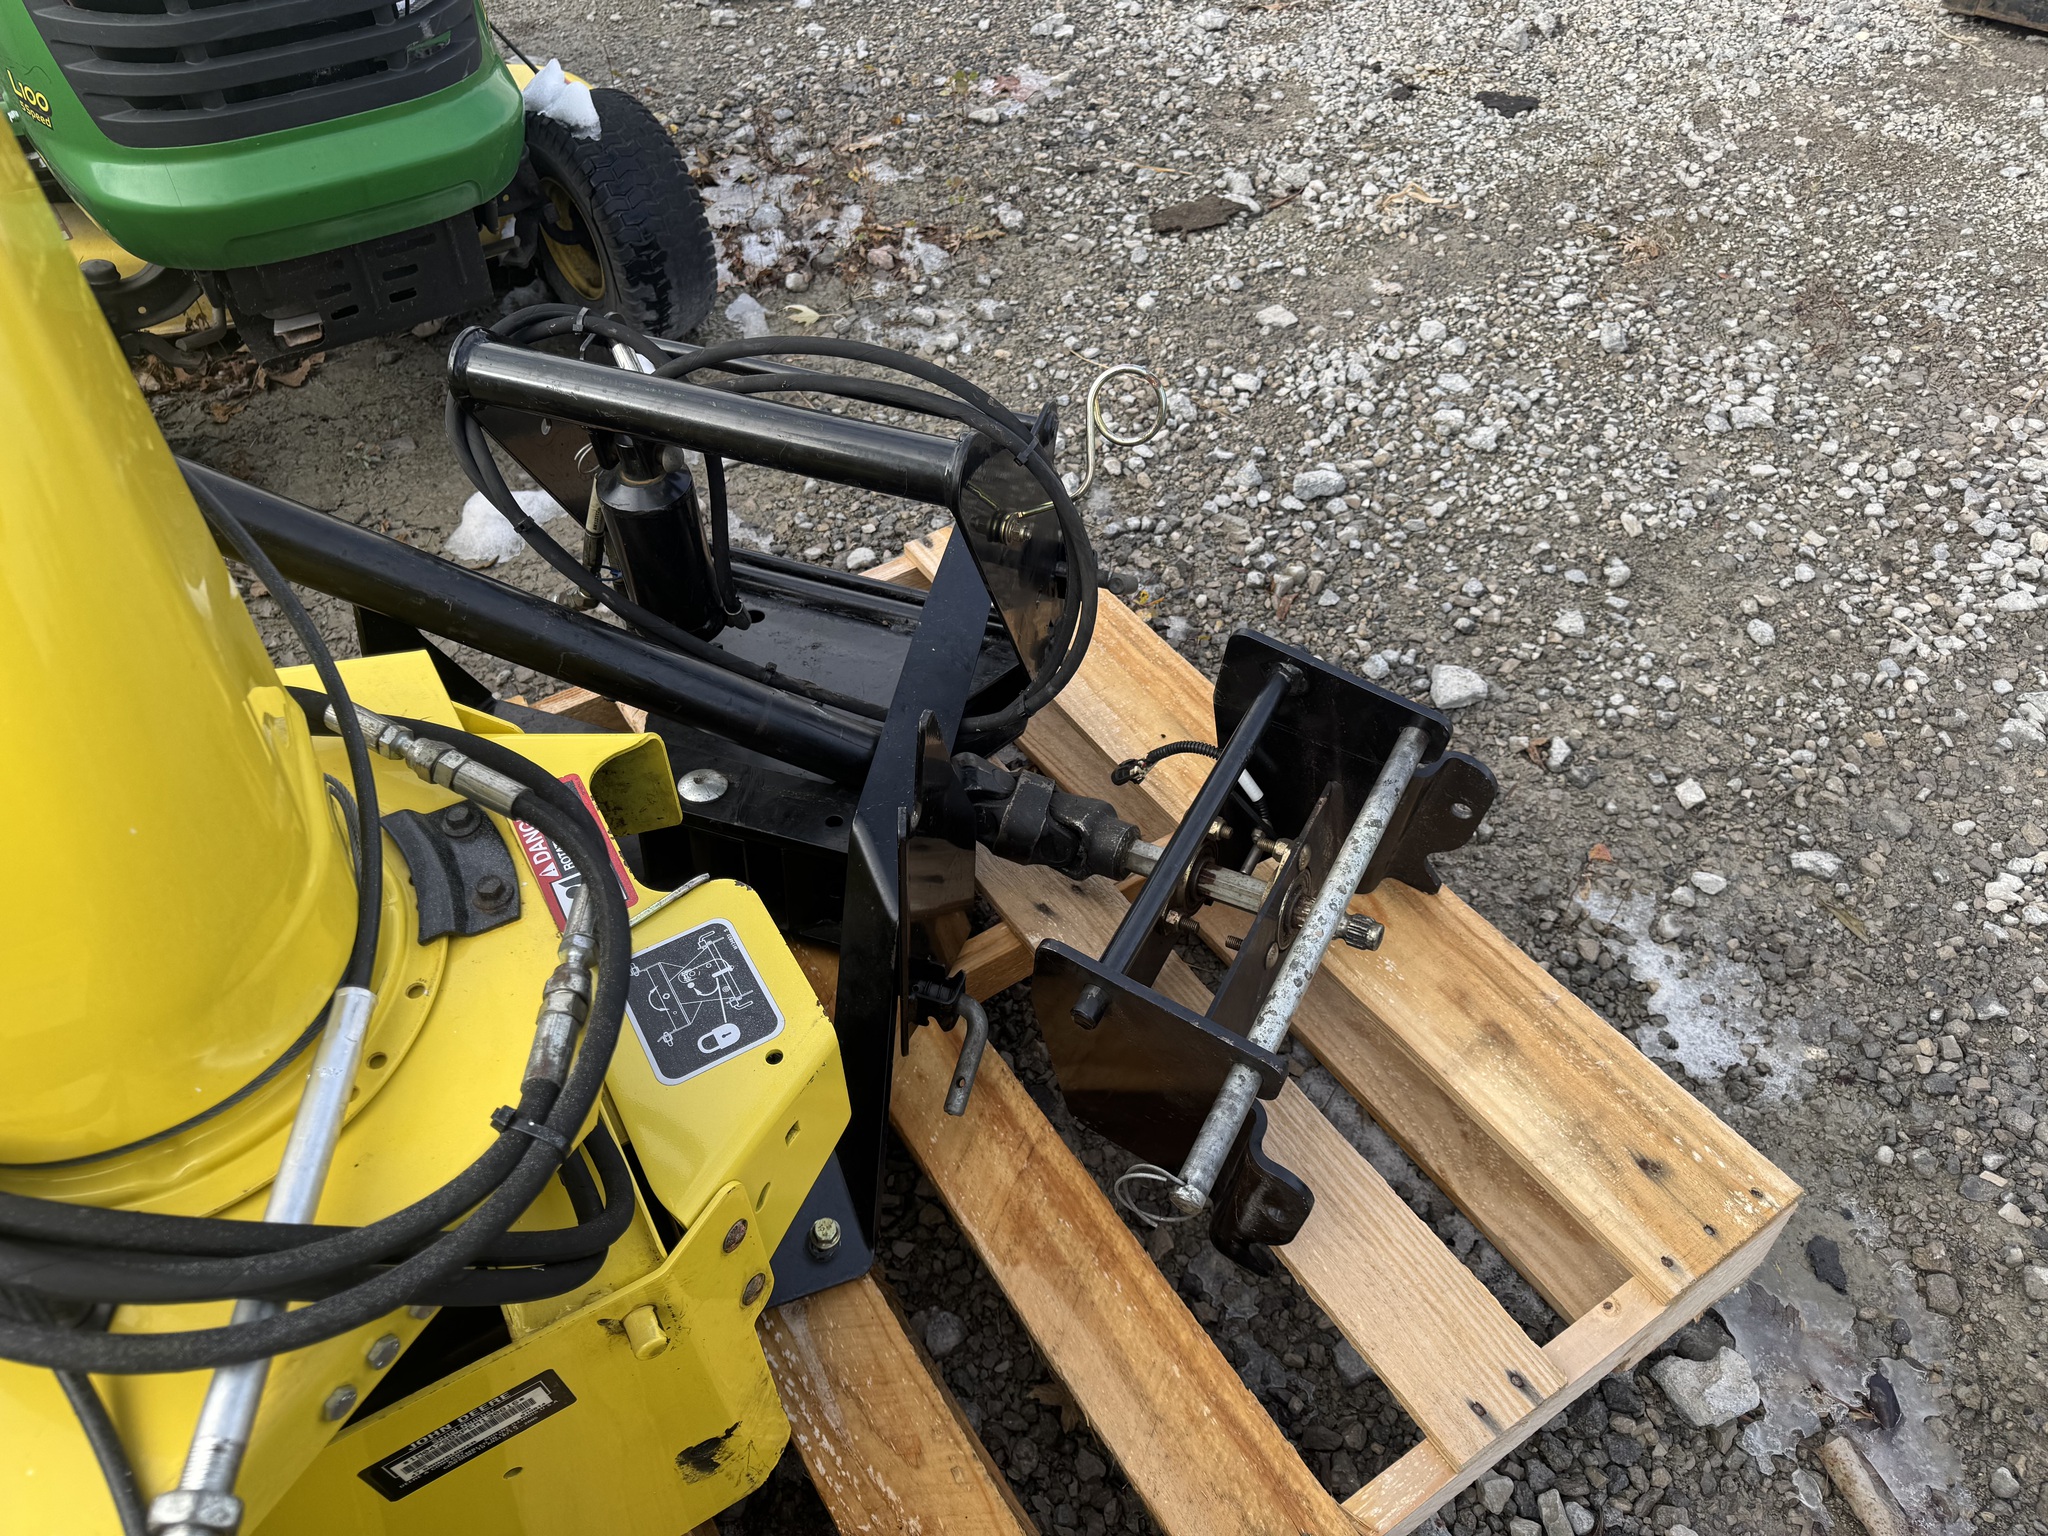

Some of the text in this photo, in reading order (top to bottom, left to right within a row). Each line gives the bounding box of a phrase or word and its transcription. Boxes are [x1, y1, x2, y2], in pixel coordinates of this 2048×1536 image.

[6, 69, 49, 112] L100
[517, 819, 552, 865] DANG
[552, 840, 576, 871] ROTA
[408, 1424, 452, 1451] JOHN
[457, 1392, 511, 1422] DEERE
[432, 1409, 495, 1445] Serial Number
